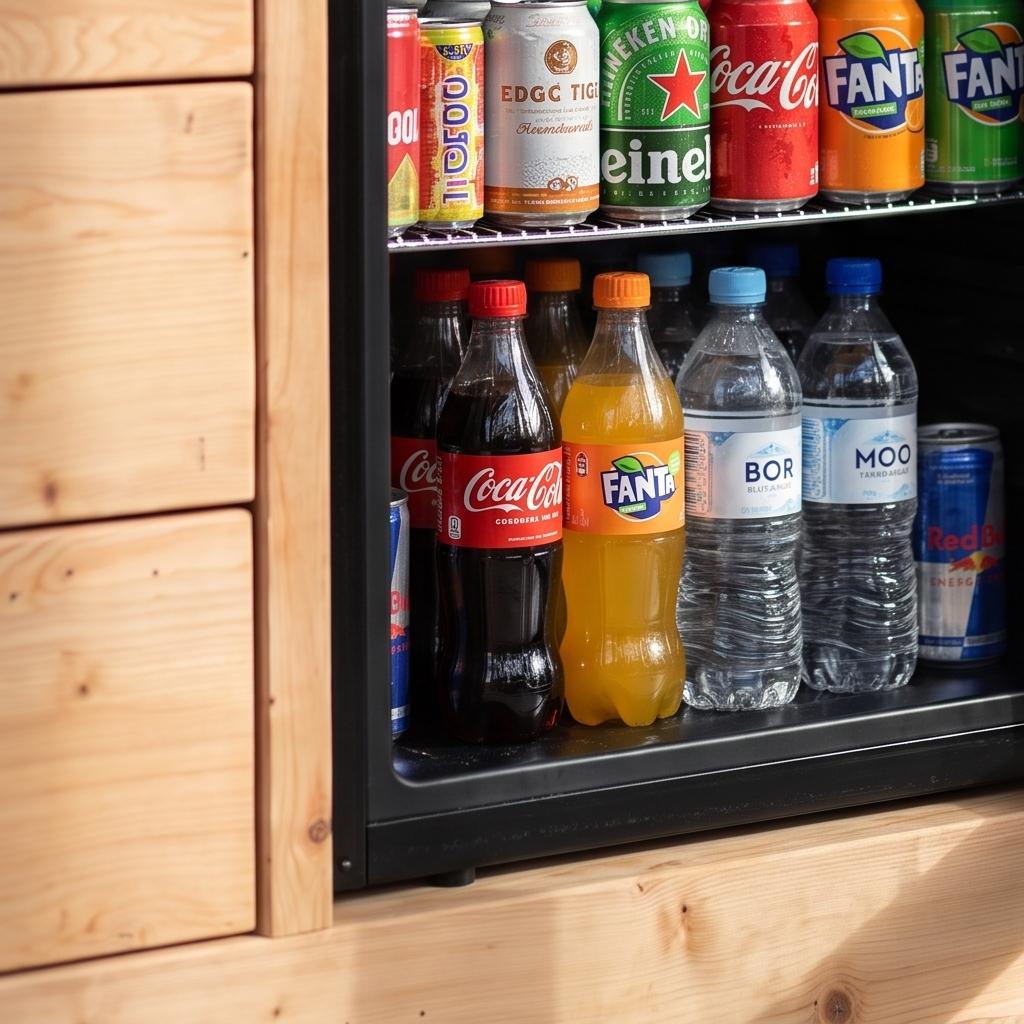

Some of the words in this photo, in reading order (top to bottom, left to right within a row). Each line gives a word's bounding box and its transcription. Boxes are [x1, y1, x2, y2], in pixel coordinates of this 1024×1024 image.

[745, 458, 794, 482] BOR
[855, 444, 911, 469] MOO
[602, 465, 676, 504] FANTA
[927, 522, 978, 551] Red
